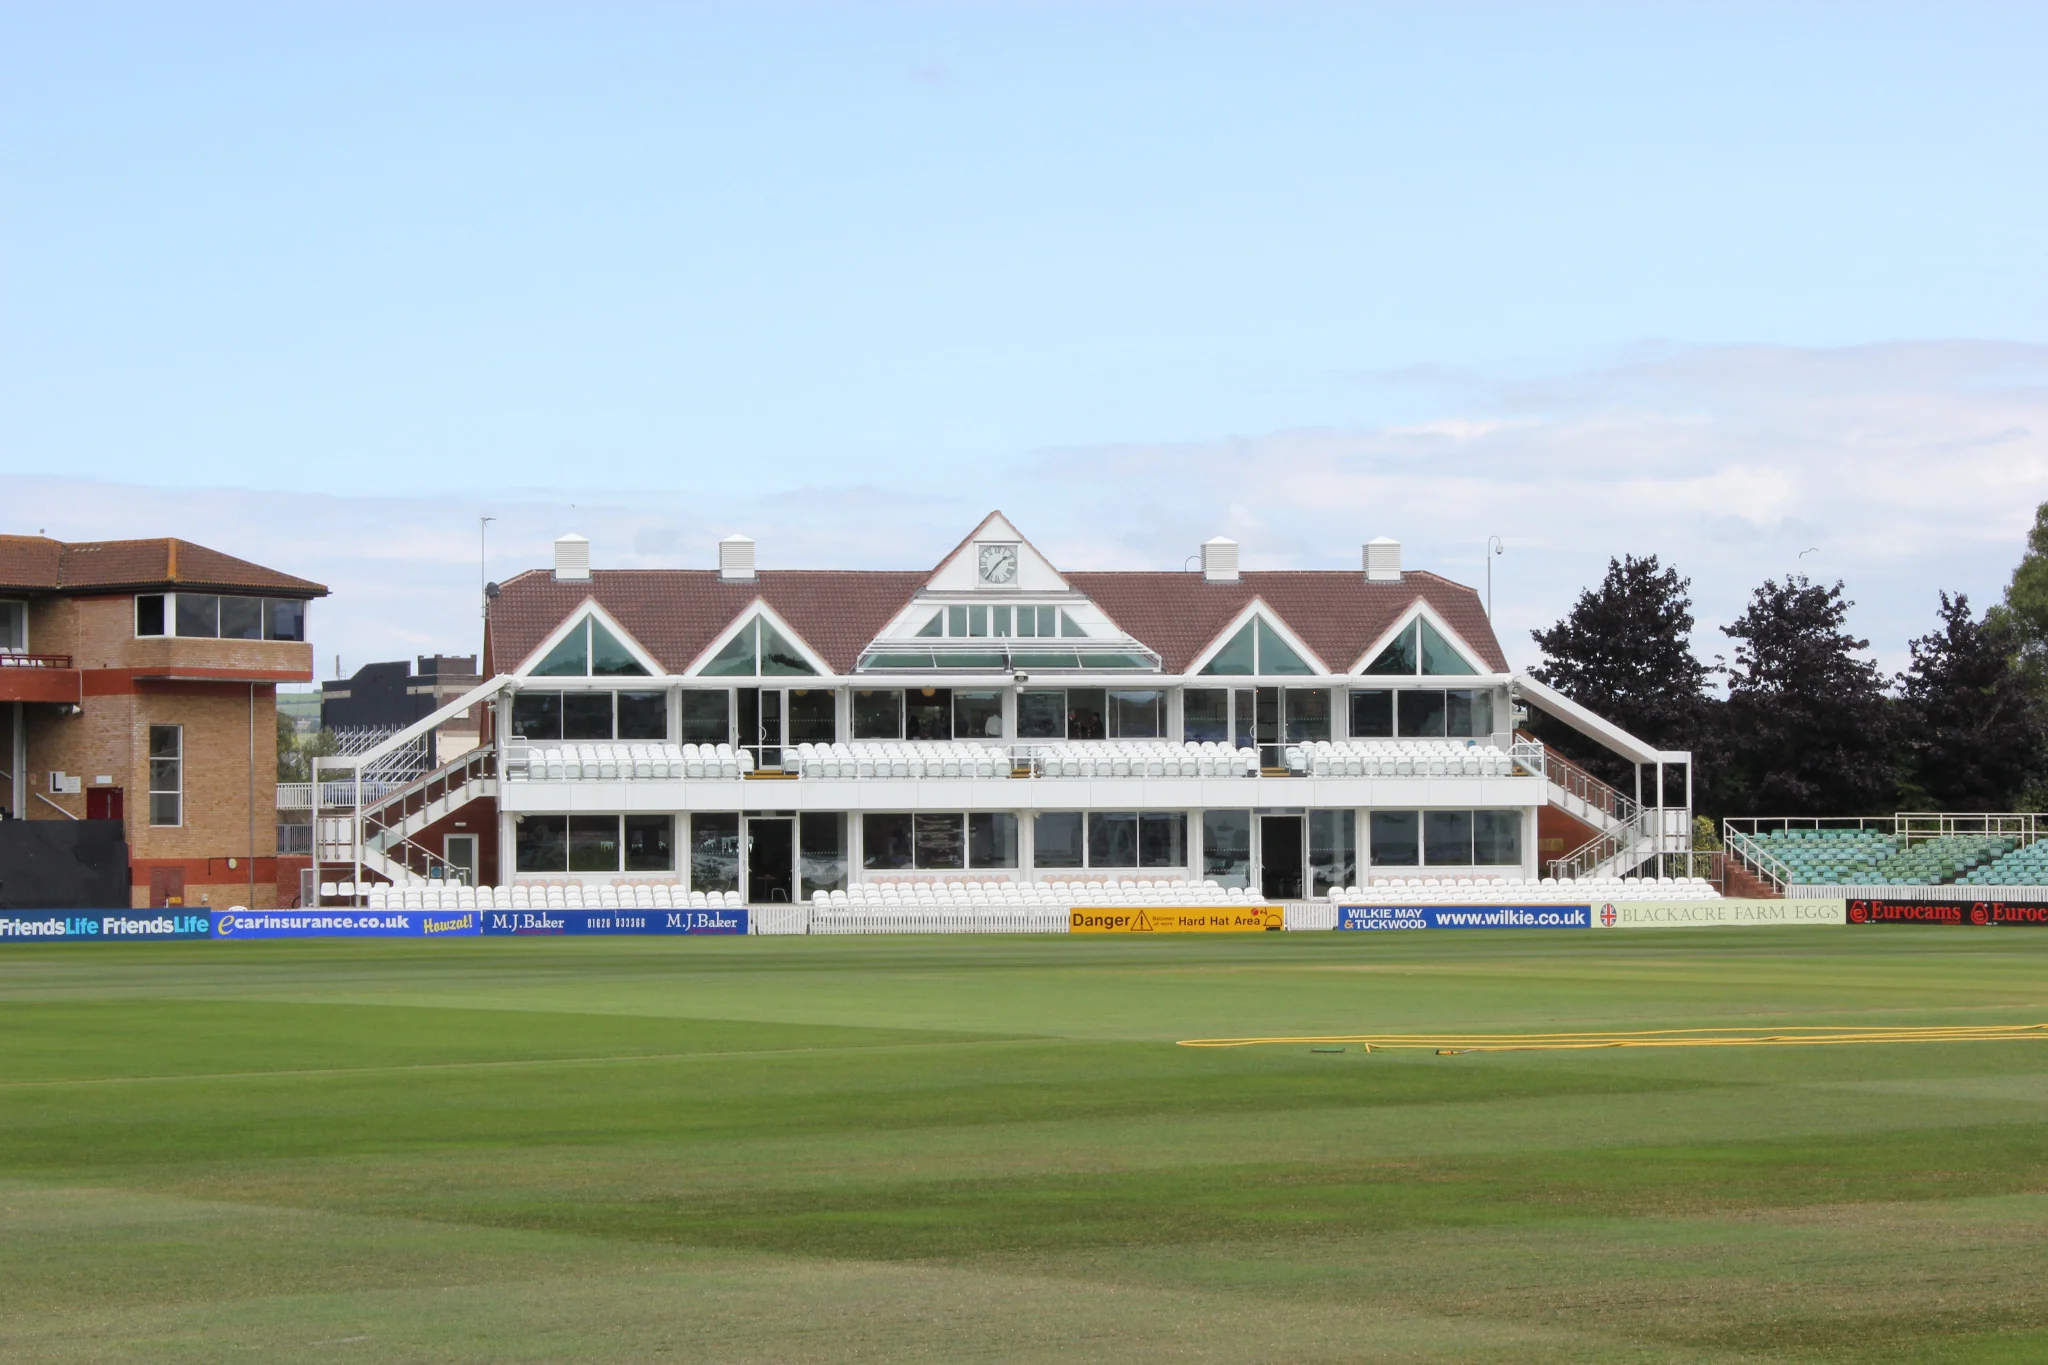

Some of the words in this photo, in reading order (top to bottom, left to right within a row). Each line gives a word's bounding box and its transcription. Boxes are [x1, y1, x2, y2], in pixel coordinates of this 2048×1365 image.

[1348, 909, 1392, 919] WILKIE
[1395, 909, 1423, 919] MAY
[1435, 910, 1586, 926] www.wilkie.co.uk
[1623, 907, 1726, 922] BLACKACRE
[1735, 906, 1785, 920] FARM
[1796, 905, 1839, 919] EGGS
[1871, 901, 1961, 919] Eurocams
[0, 918, 99, 936] FriendsLife
[103, 916, 209, 934] FriendsLife
[423, 914, 473, 935] Howzat!
[587, 918, 611, 928] 01626
[615, 917, 646, 928] 833366
[1072, 913, 1130, 929] Danger
[1178, 916, 1205, 926] Hard
[1210, 916, 1230, 926] Hat
[1234, 916, 1261, 926] Area
[1344, 919, 1354, 929] &
[1355, 919, 1427, 929] TUCKWOOD
